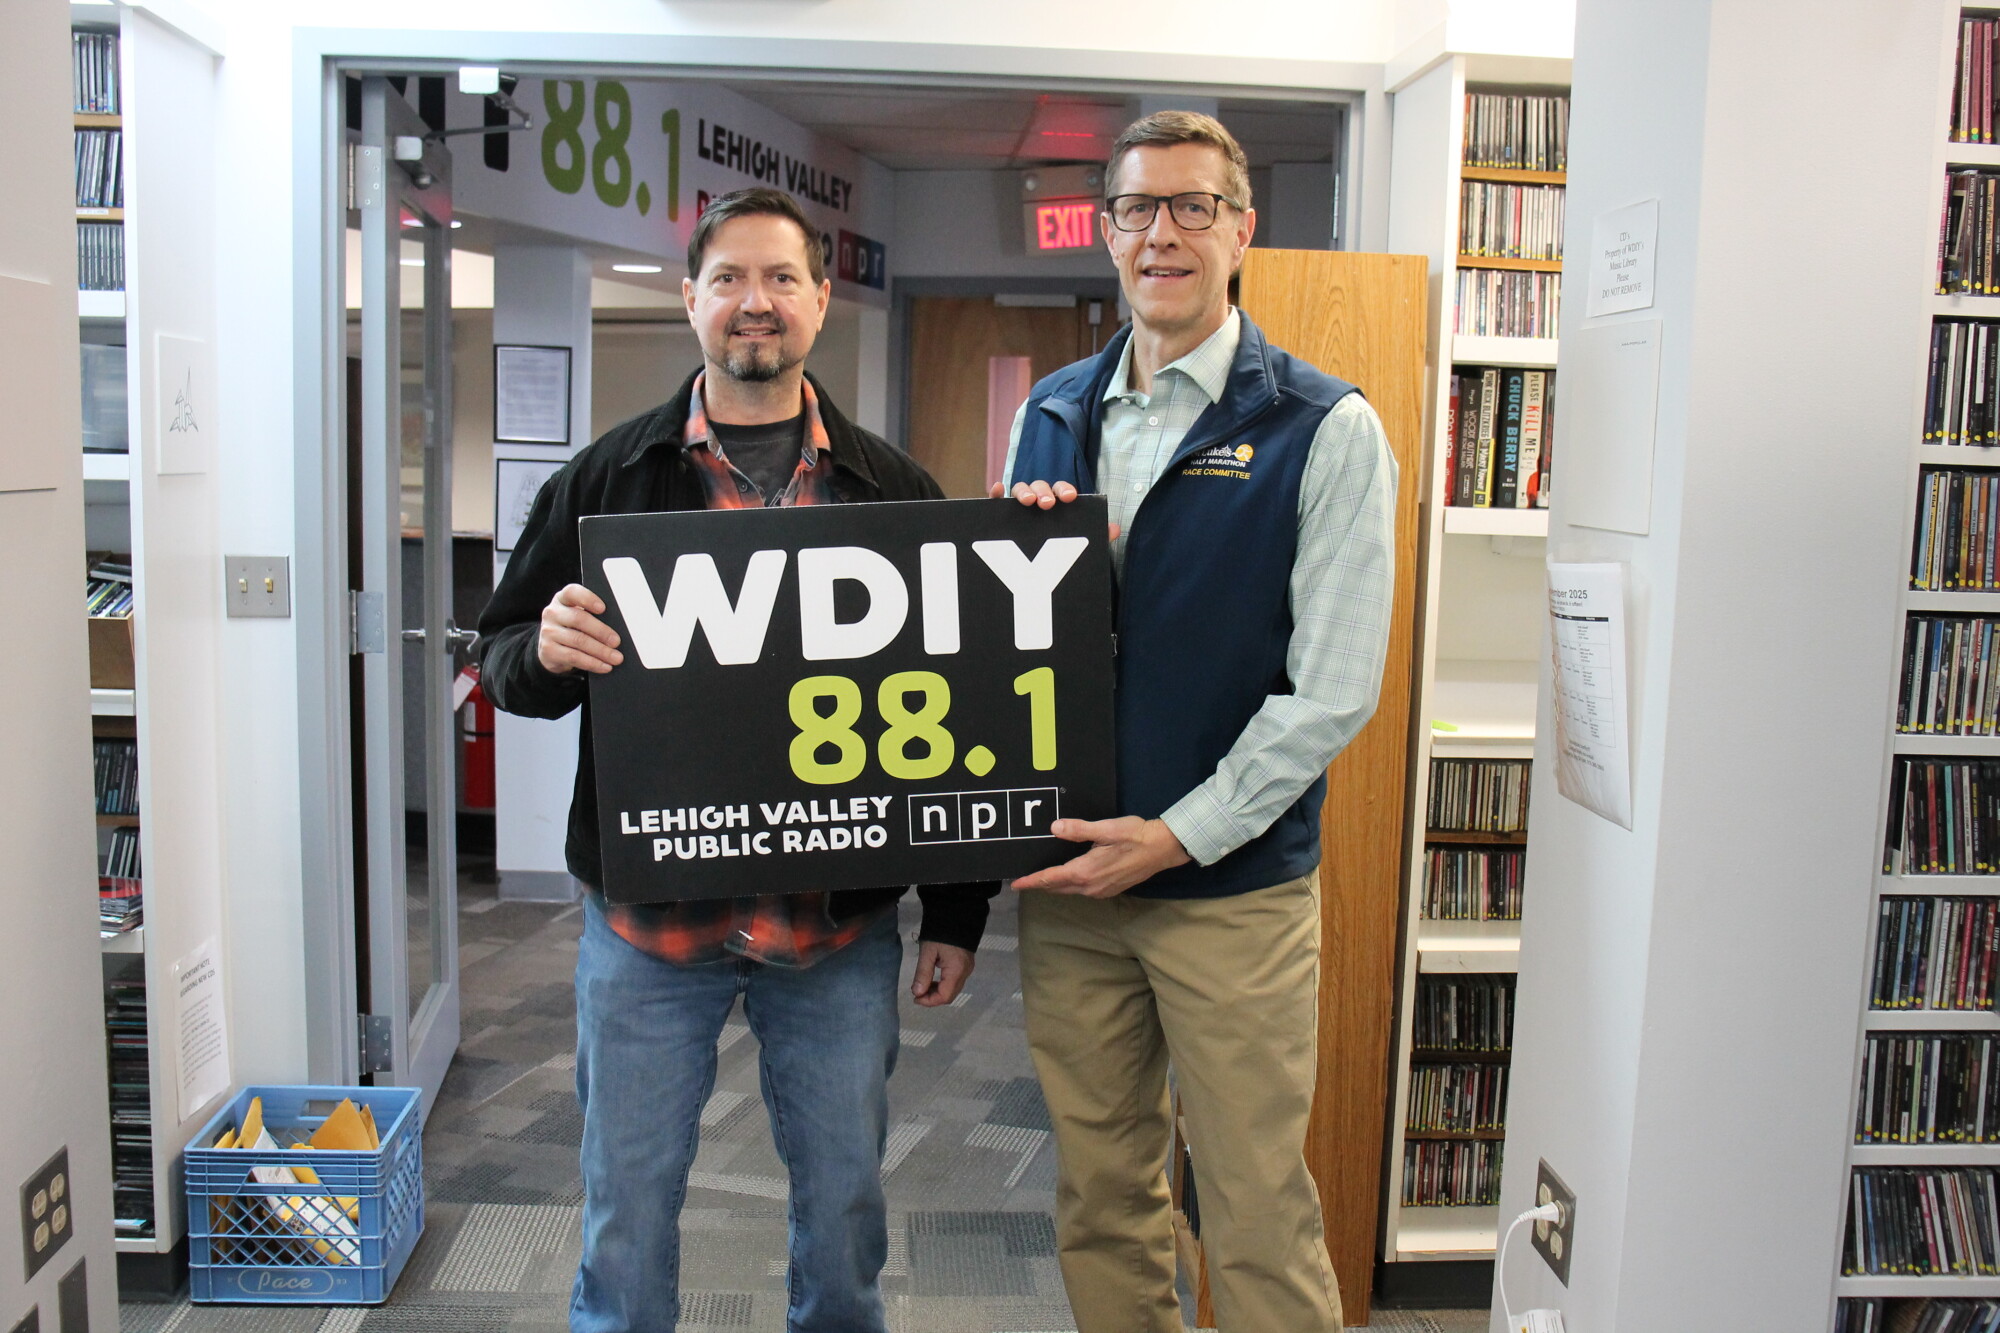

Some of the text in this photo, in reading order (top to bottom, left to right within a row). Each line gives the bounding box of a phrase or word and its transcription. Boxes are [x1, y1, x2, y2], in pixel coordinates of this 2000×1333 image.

[541, 79, 680, 222] 88.1
[698, 118, 780, 187] LEHIGH
[785, 155, 852, 213] VALLEY
[1037, 204, 1095, 249] EXIT
[840, 238, 883, 284] npr
[1623, 258, 1637, 269] Library
[1610, 286, 1620, 297] NOT
[1621, 282, 1642, 295] REMOVE
[1481, 373, 1494, 438] PUNK ROCK BLITZKRIEG
[1530, 374, 1540, 402] PLEASE
[1504, 375, 1522, 472] CHUCK BERRY
[1208, 458, 1247, 468] MARATHON
[1465, 441, 1475, 469] GUTHRIE
[1524, 438, 1537, 454] ME
[1182, 468, 1251, 480] RACE COMMITTEE
[602, 536, 1090, 670] WDIY
[1569, 589, 1588, 600] 2025
[788, 666, 1057, 785] 88.1
[620, 796, 893, 835] LEHIGH VALLEY
[920, 795, 1044, 841] npr
[653, 825, 888, 862] PUBLIC RADIO
[257, 1271, 313, 1292] Pace
